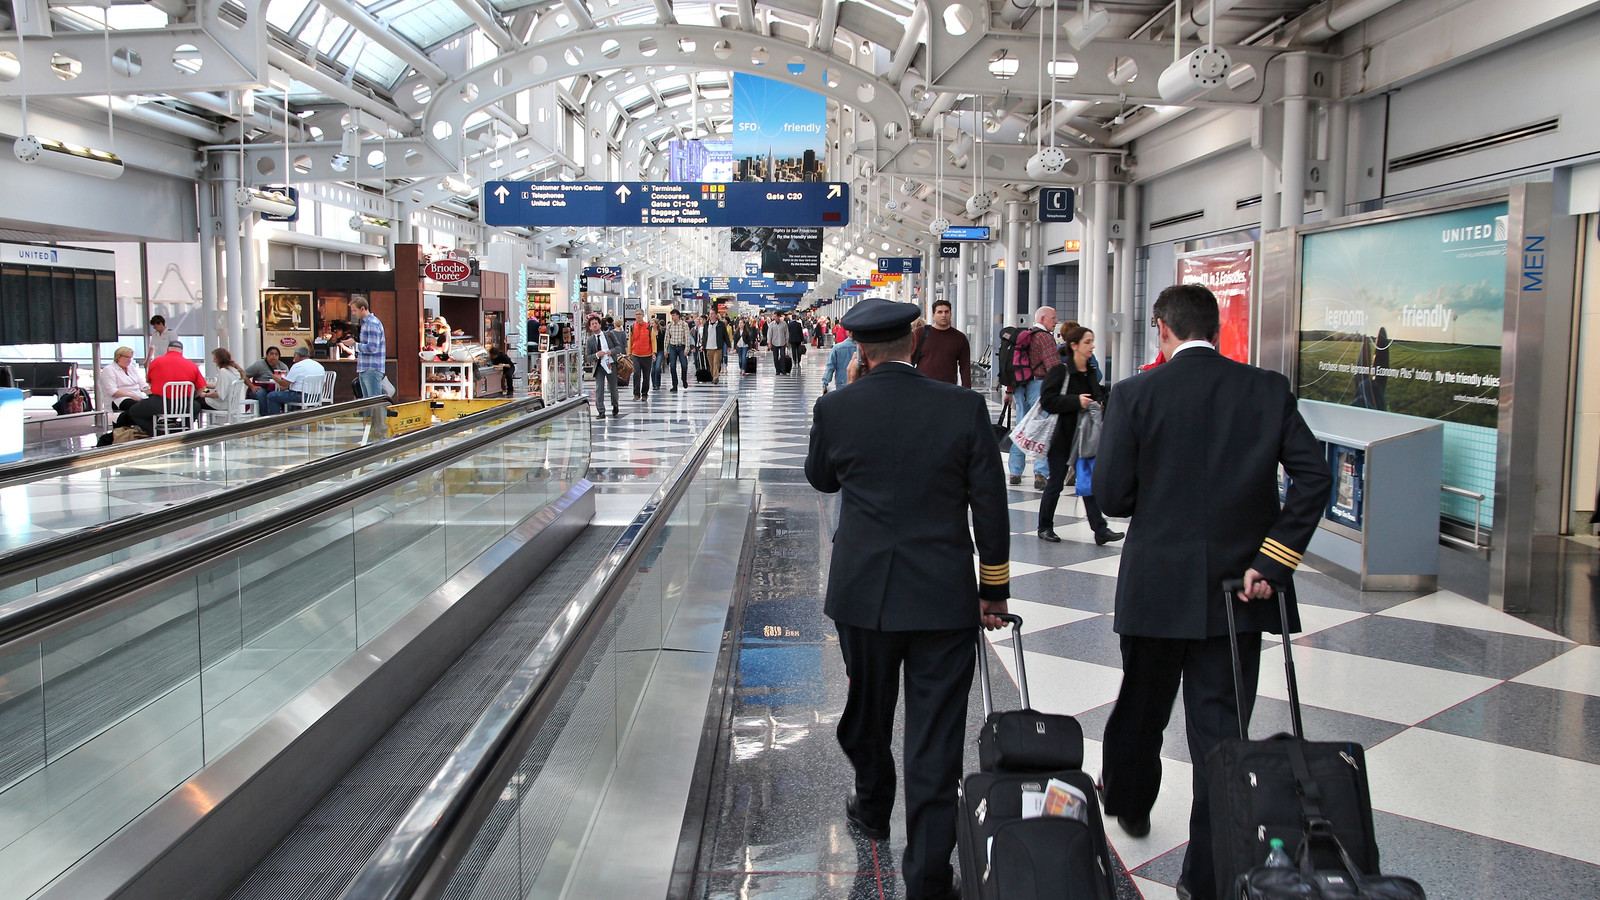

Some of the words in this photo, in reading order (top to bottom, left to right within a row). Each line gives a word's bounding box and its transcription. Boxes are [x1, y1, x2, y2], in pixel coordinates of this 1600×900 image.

[738, 123, 757, 131] SFO
[784, 123, 821, 133] friendly
[1442, 224, 1492, 243] UNITED
[19, 250, 48, 259] UNITED
[1523, 236, 1545, 291] MEN
[431, 263, 465, 272] Brioche
[436, 271, 460, 280] Dorée
[1220, 270, 1246, 286] Episodes.
[516, 264, 527, 303] News
[1325, 307, 1364, 329] legroom
[1402, 304, 1452, 331] friendly
[516, 303, 527, 357] Hudson
[1319, 361, 1338, 372] Purchase
[1339, 364, 1350, 372] more
[1351, 363, 1369, 375] legroom
[1370, 365, 1375, 374] in
[1376, 366, 1399, 378] Economy
[1415, 369, 1433, 382] today.
[1435, 371, 1444, 383] fly
[1445, 371, 1455, 383] the
[1456, 371, 1482, 387] friendly
[1482, 374, 1500, 387] skies
[1015, 430, 1045, 454] PARIS
